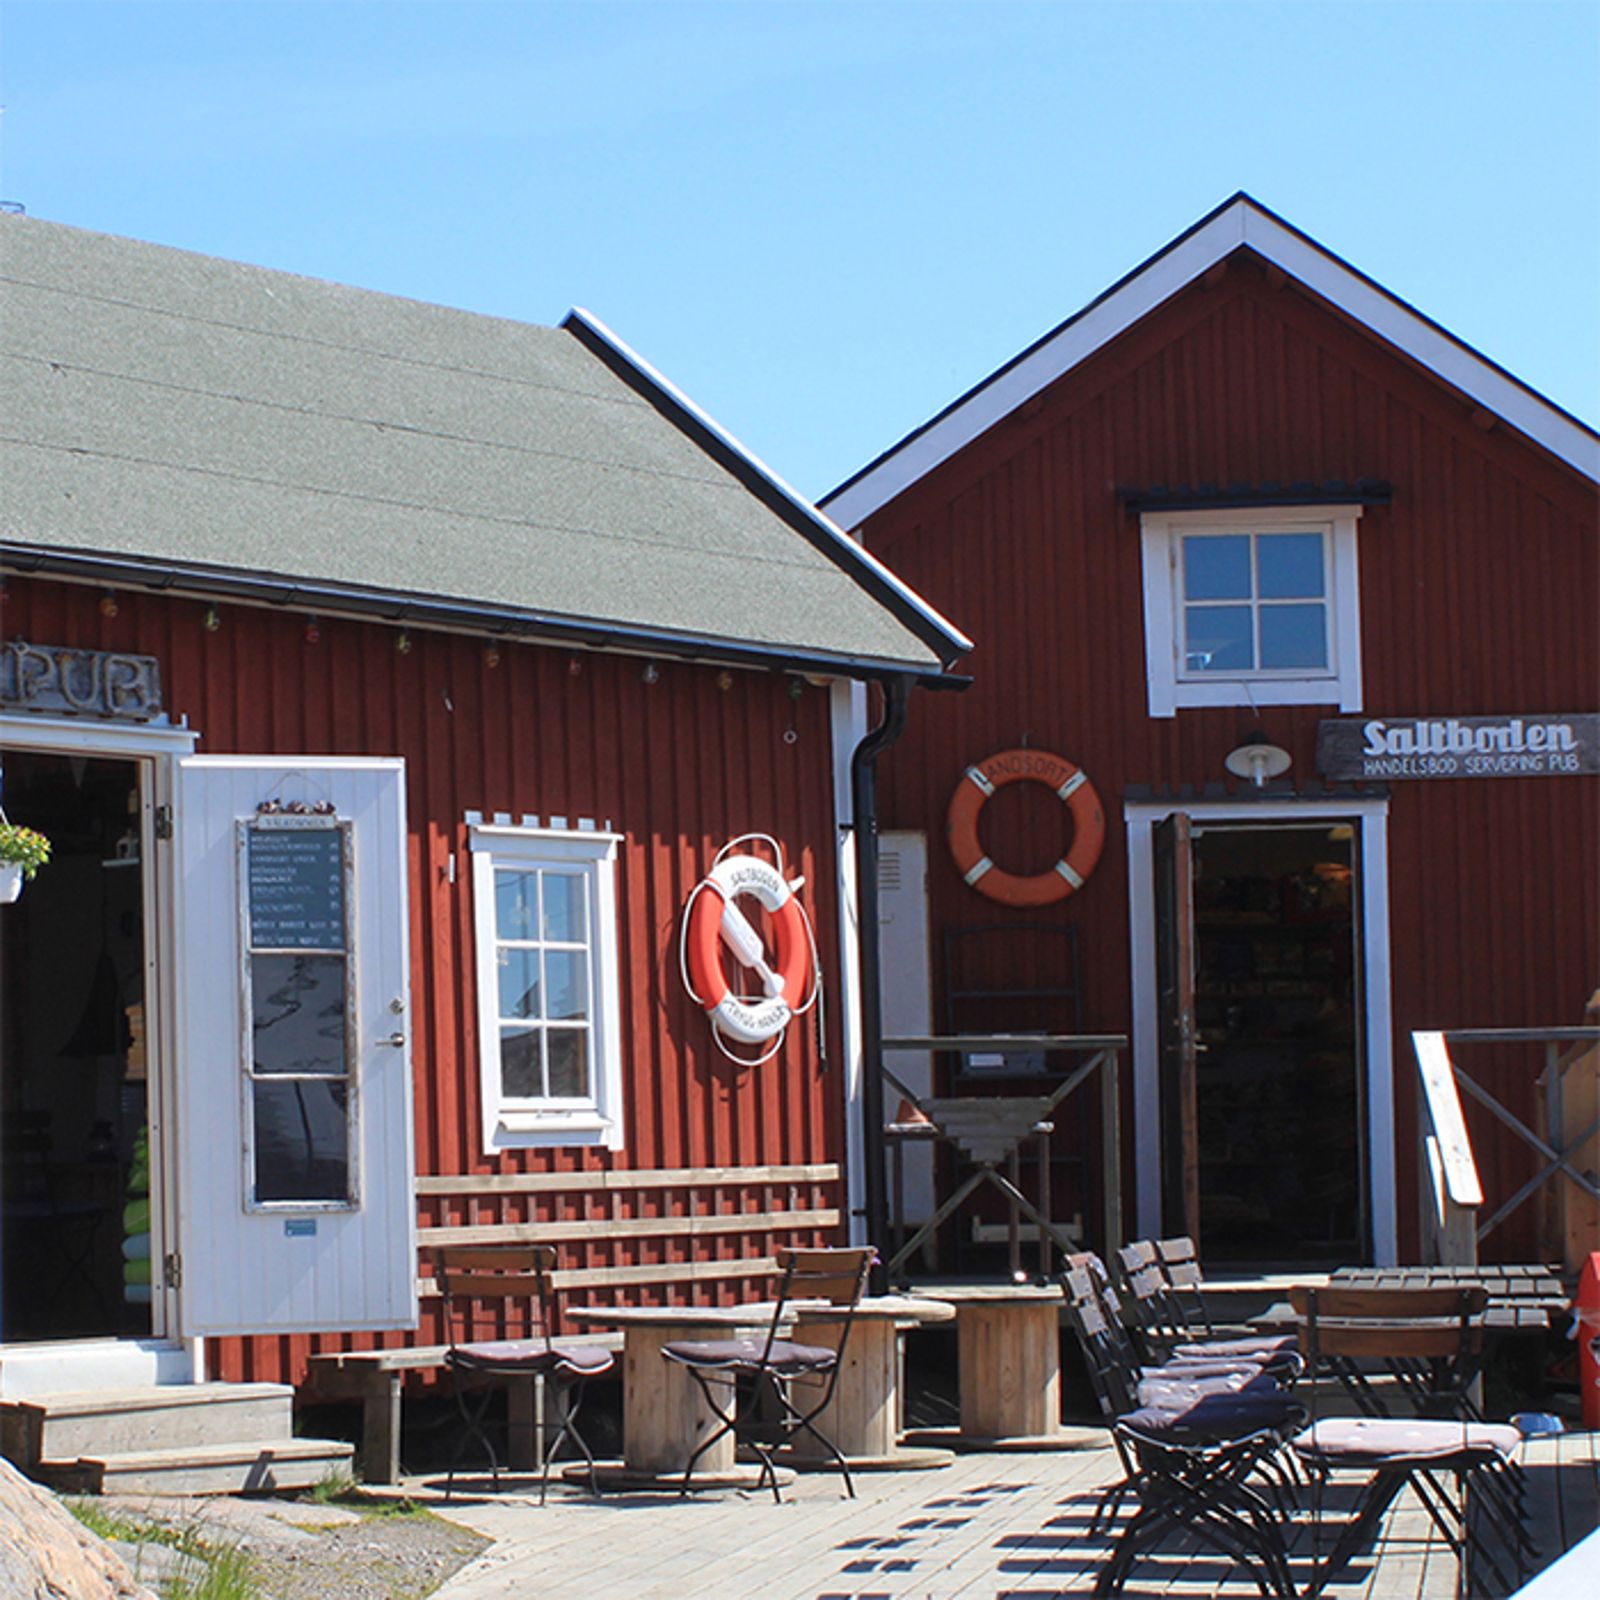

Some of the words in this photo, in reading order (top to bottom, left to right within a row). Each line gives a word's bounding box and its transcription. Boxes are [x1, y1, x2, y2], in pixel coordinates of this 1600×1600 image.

[15, 645, 147, 714] PUB
[1363, 719, 1579, 756] Saltboden
[1363, 757, 1459, 776] HANDELSBOD
[1463, 755, 1544, 774] SERVERING
[1549, 753, 1581, 772] PUB
